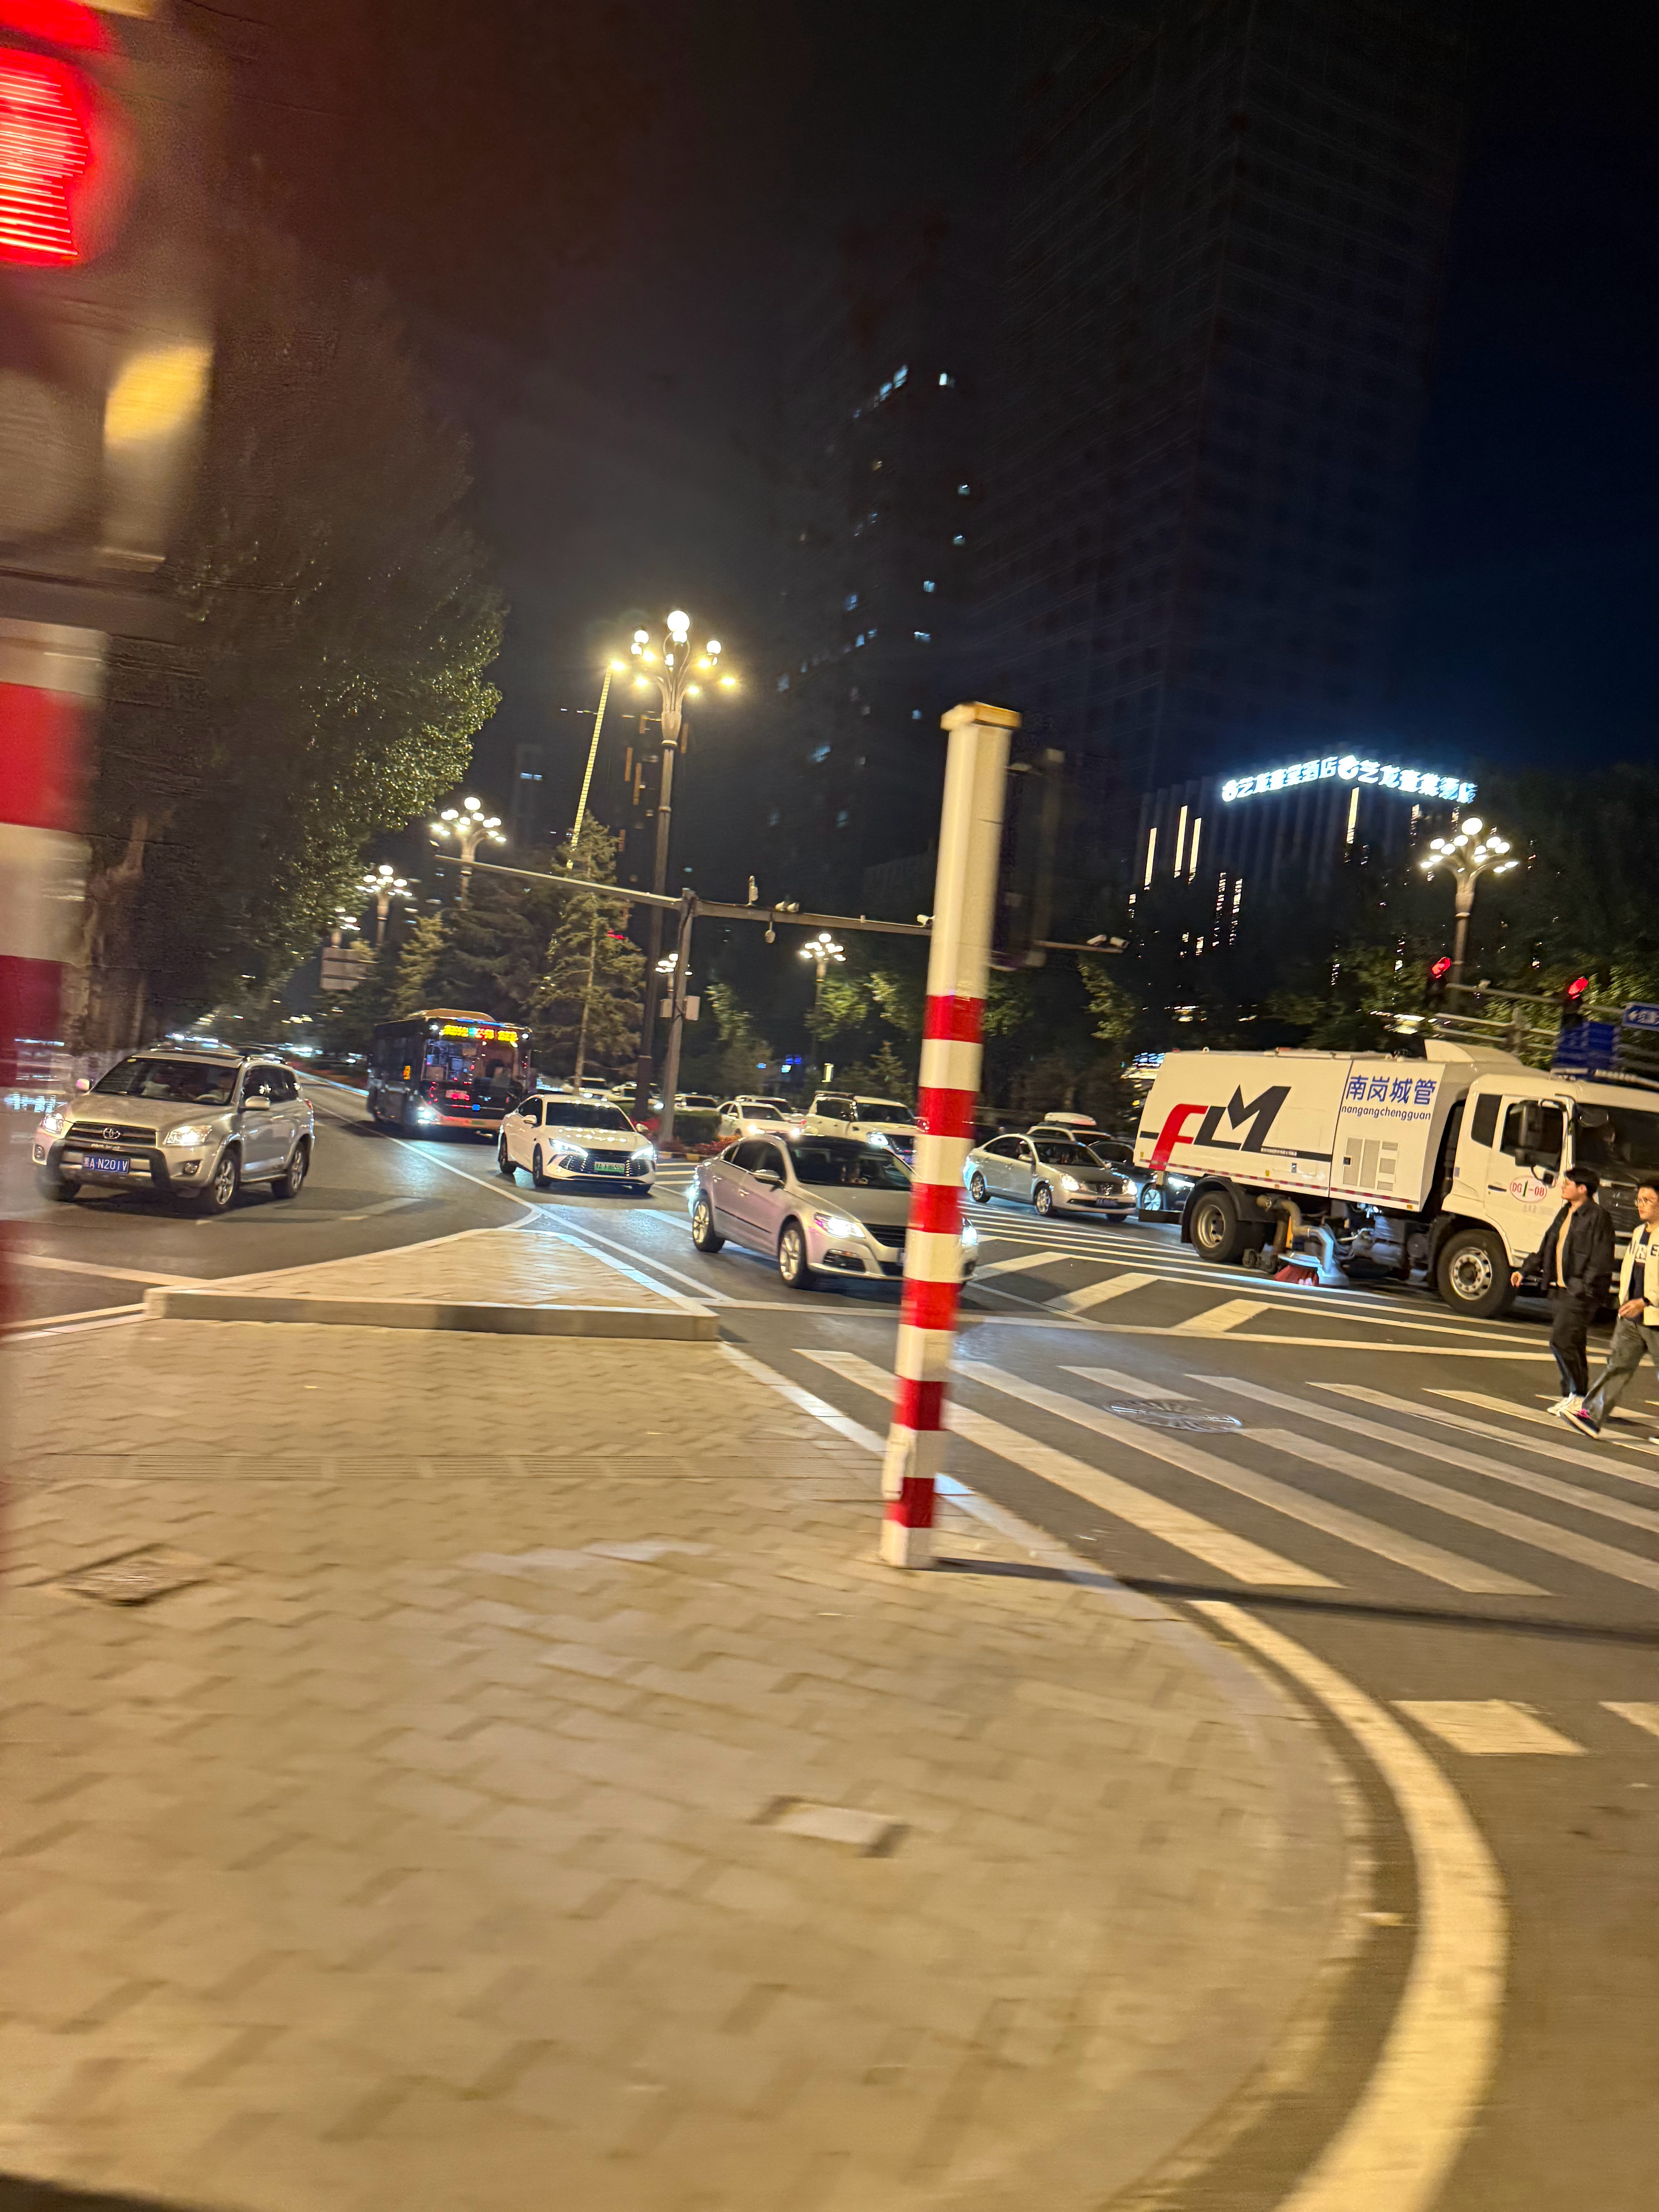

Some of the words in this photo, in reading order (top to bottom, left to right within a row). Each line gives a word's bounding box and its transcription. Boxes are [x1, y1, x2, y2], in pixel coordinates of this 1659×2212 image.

[1346, 1075, 1437, 1105] 南岗城管
[1149, 1084, 1291, 1170] FLM
